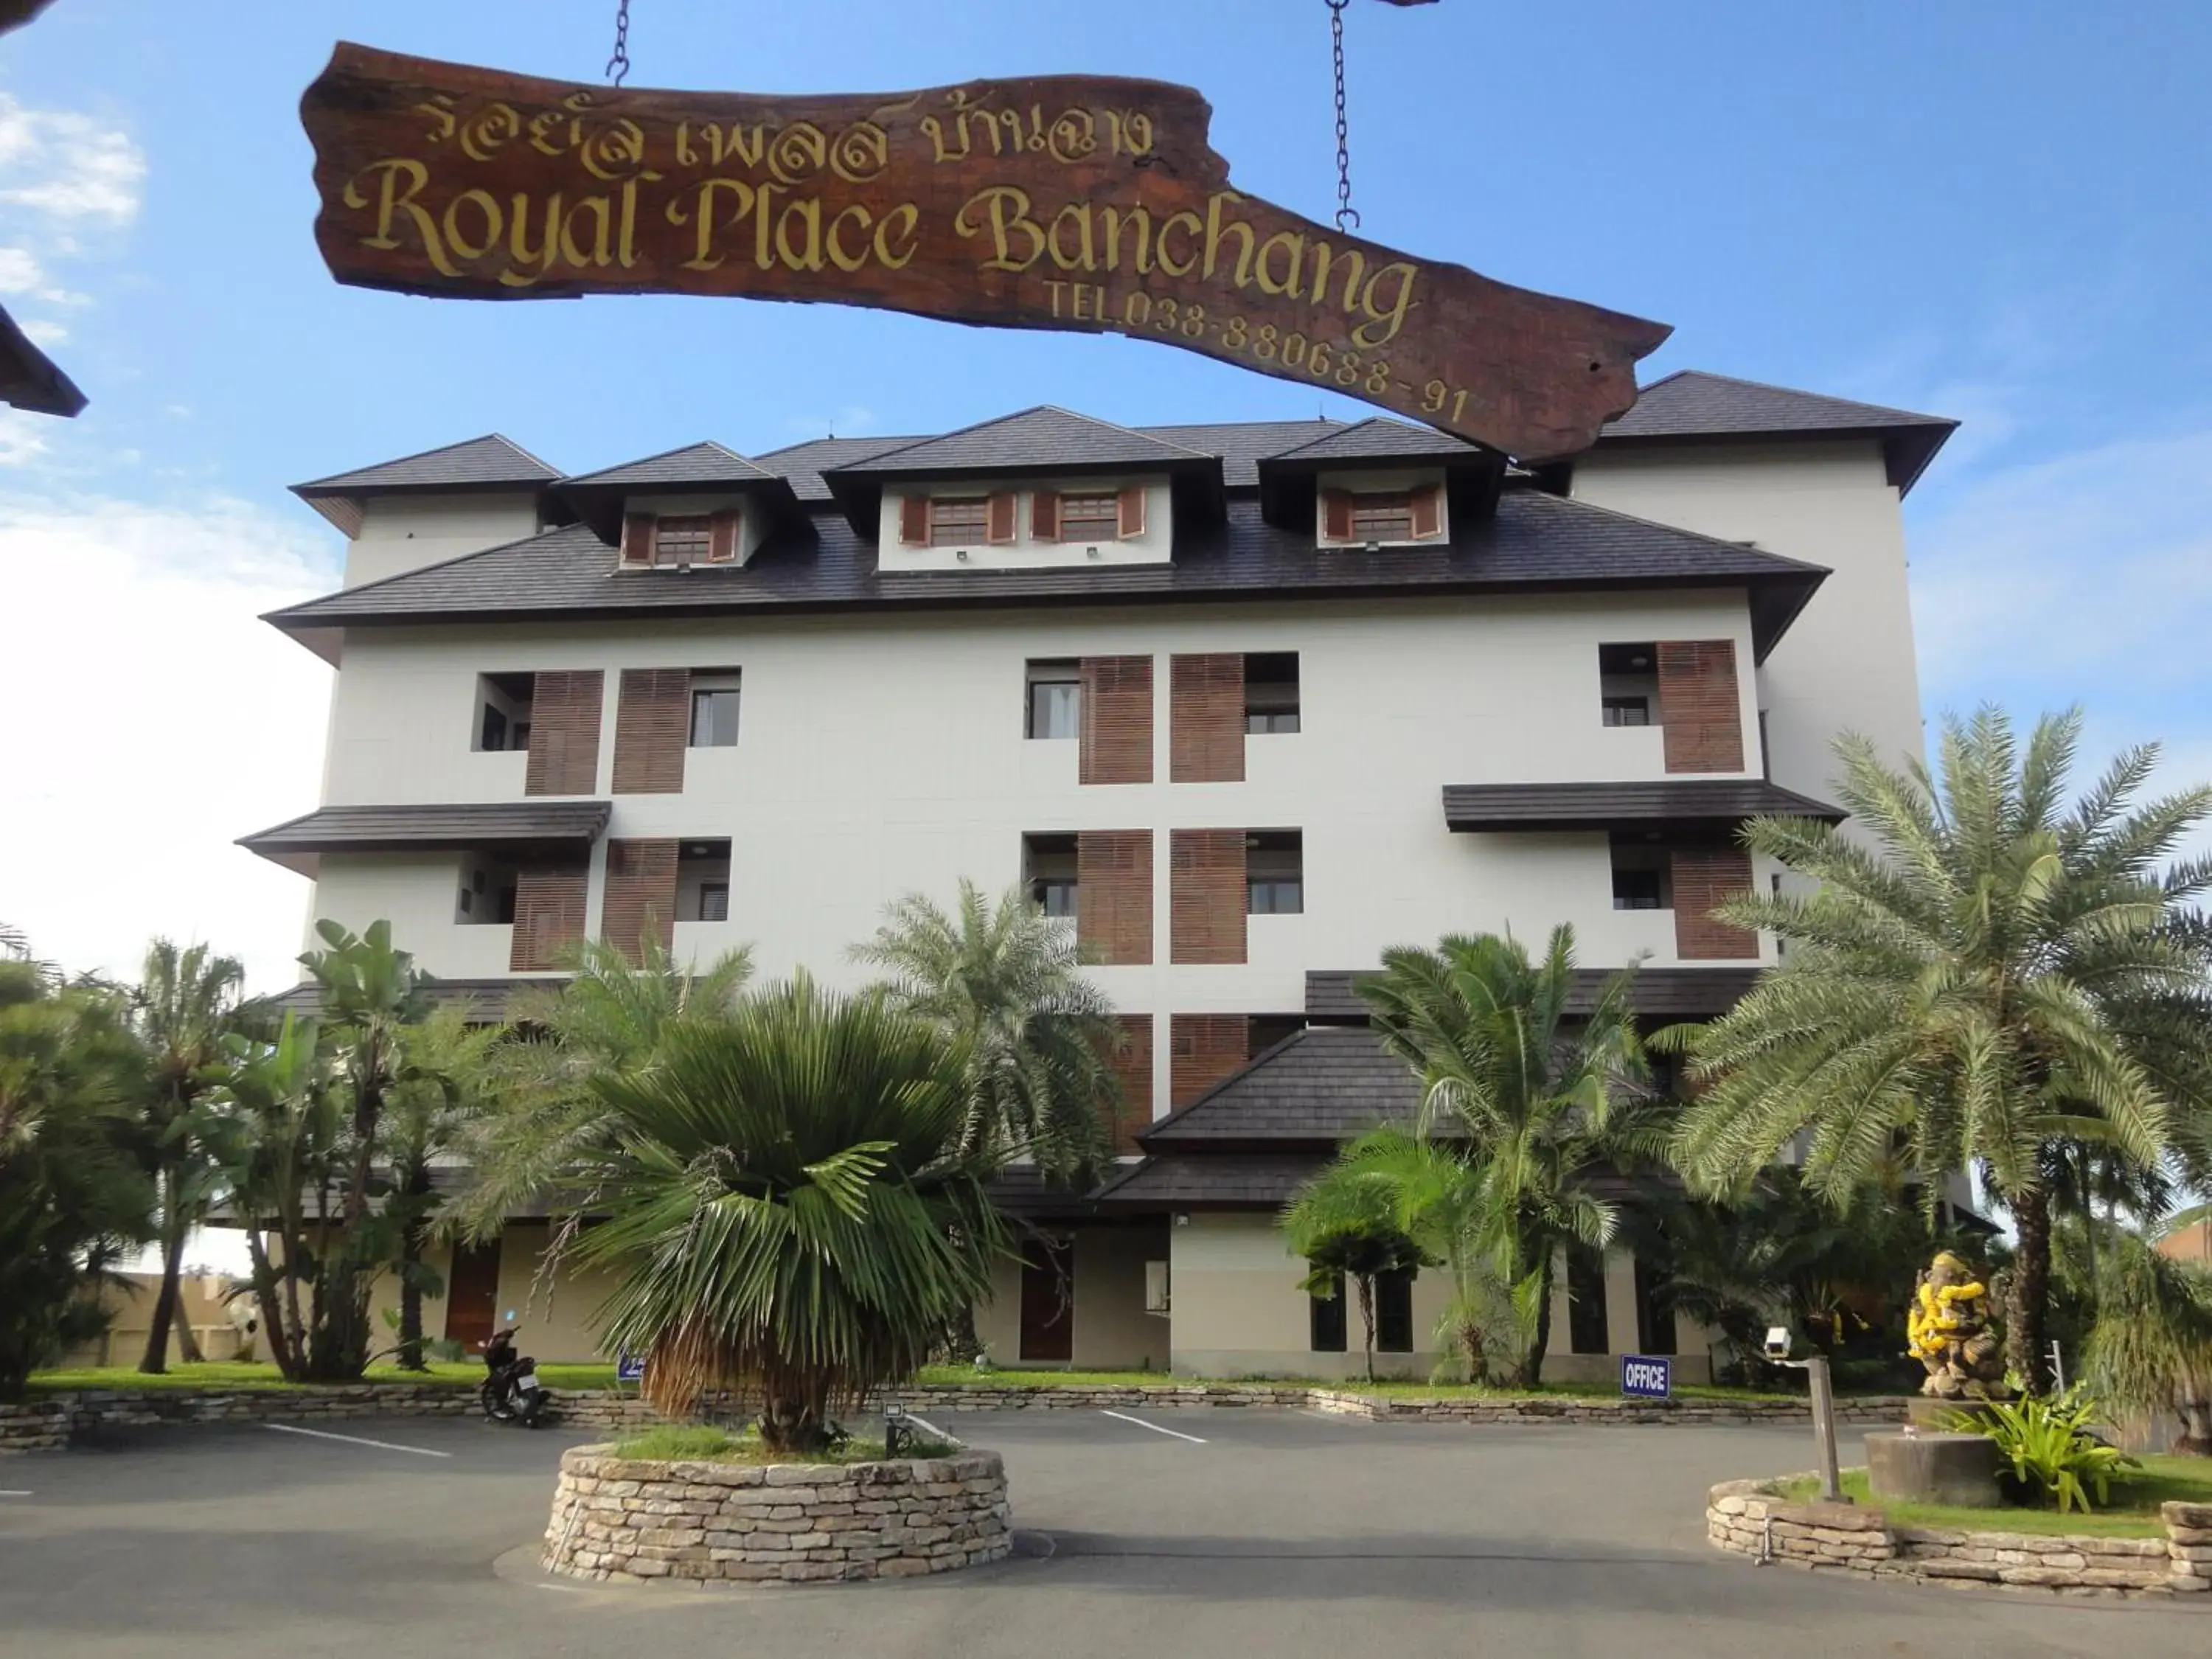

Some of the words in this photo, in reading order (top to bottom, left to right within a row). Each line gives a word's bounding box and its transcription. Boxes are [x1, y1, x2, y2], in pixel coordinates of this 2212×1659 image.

[344, 158, 663, 287] Royal
[666, 177, 919, 272] Place
[955, 184, 1423, 349] Banchang
[1625, 1362, 1666, 1391] OFFICE
